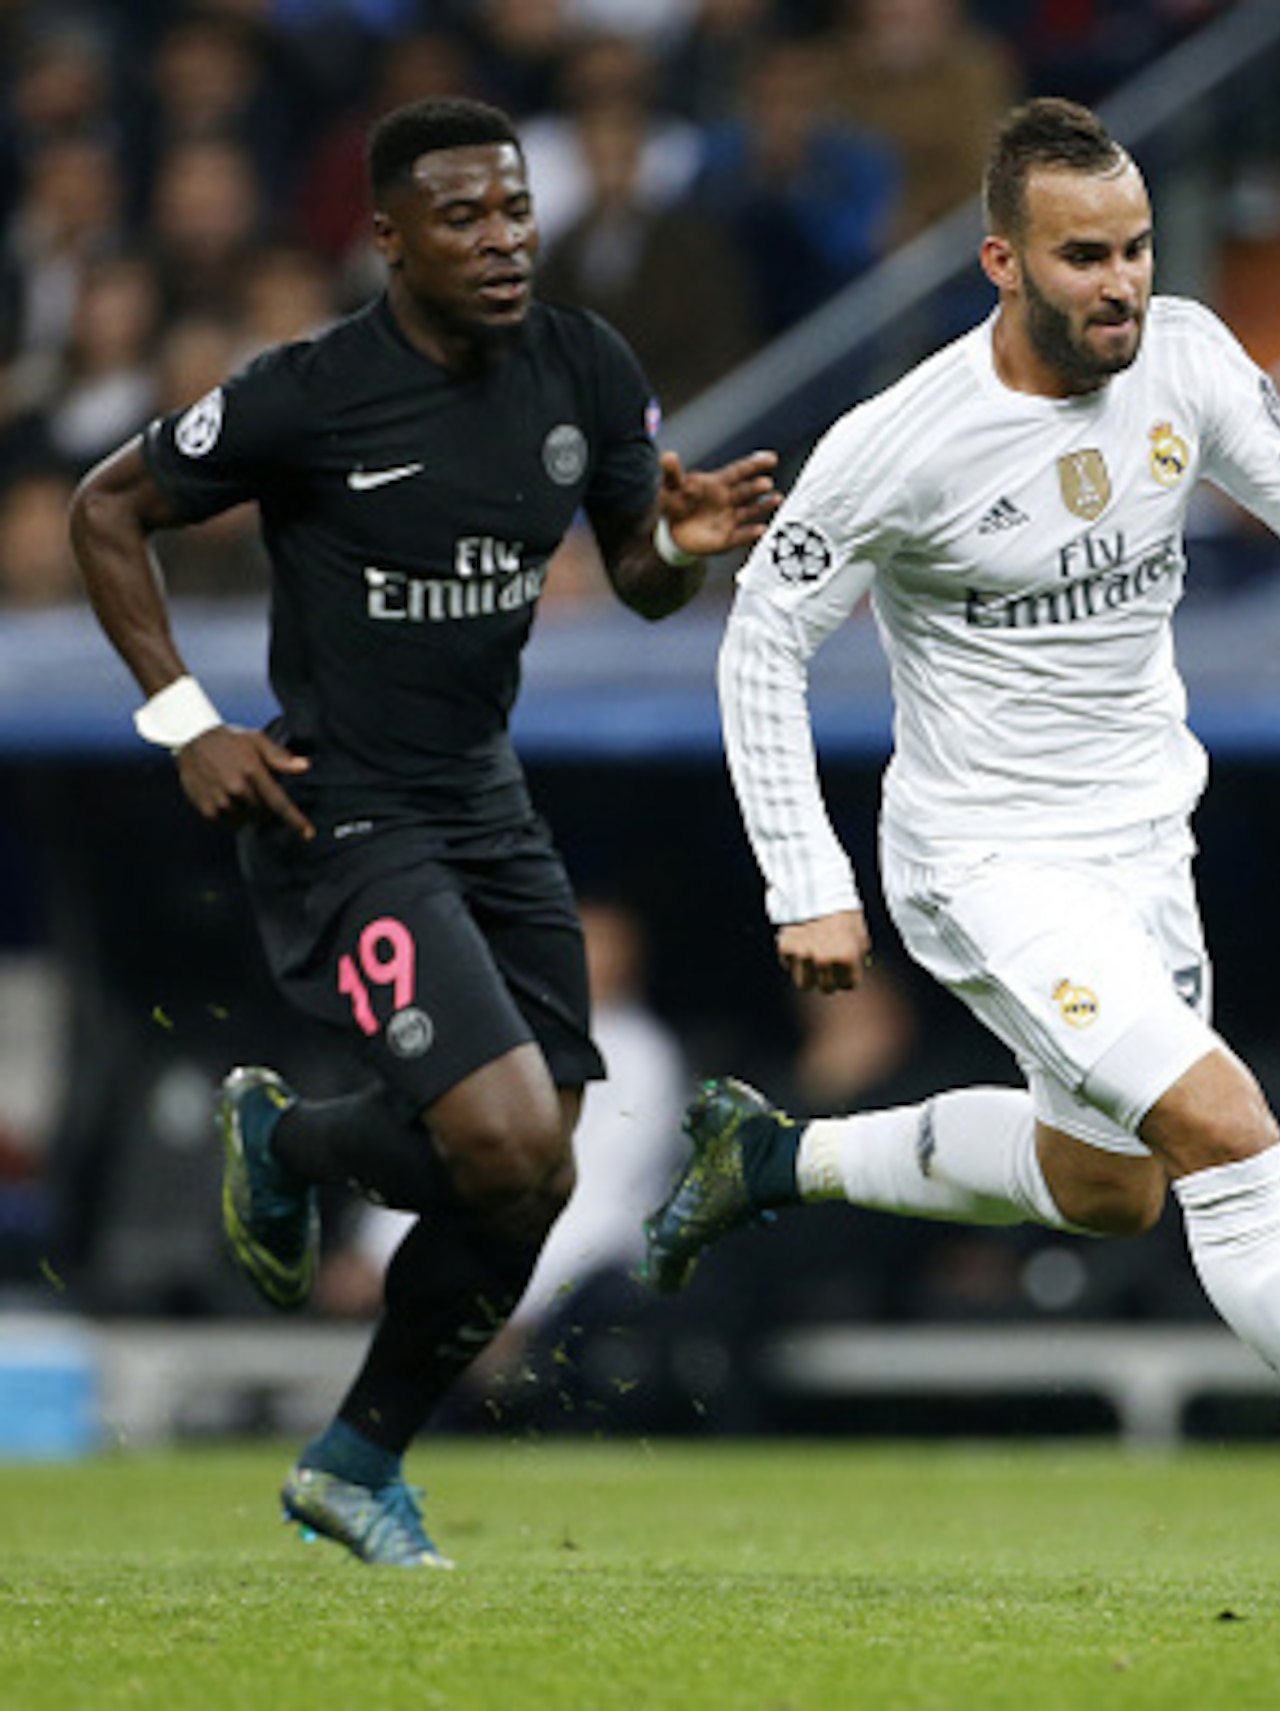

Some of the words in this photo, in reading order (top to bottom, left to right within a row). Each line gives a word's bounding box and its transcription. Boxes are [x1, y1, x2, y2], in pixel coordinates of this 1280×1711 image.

[455, 536, 523, 576] Fly
[1060, 530, 1124, 577] Fly
[337, 916, 416, 1036] 19
